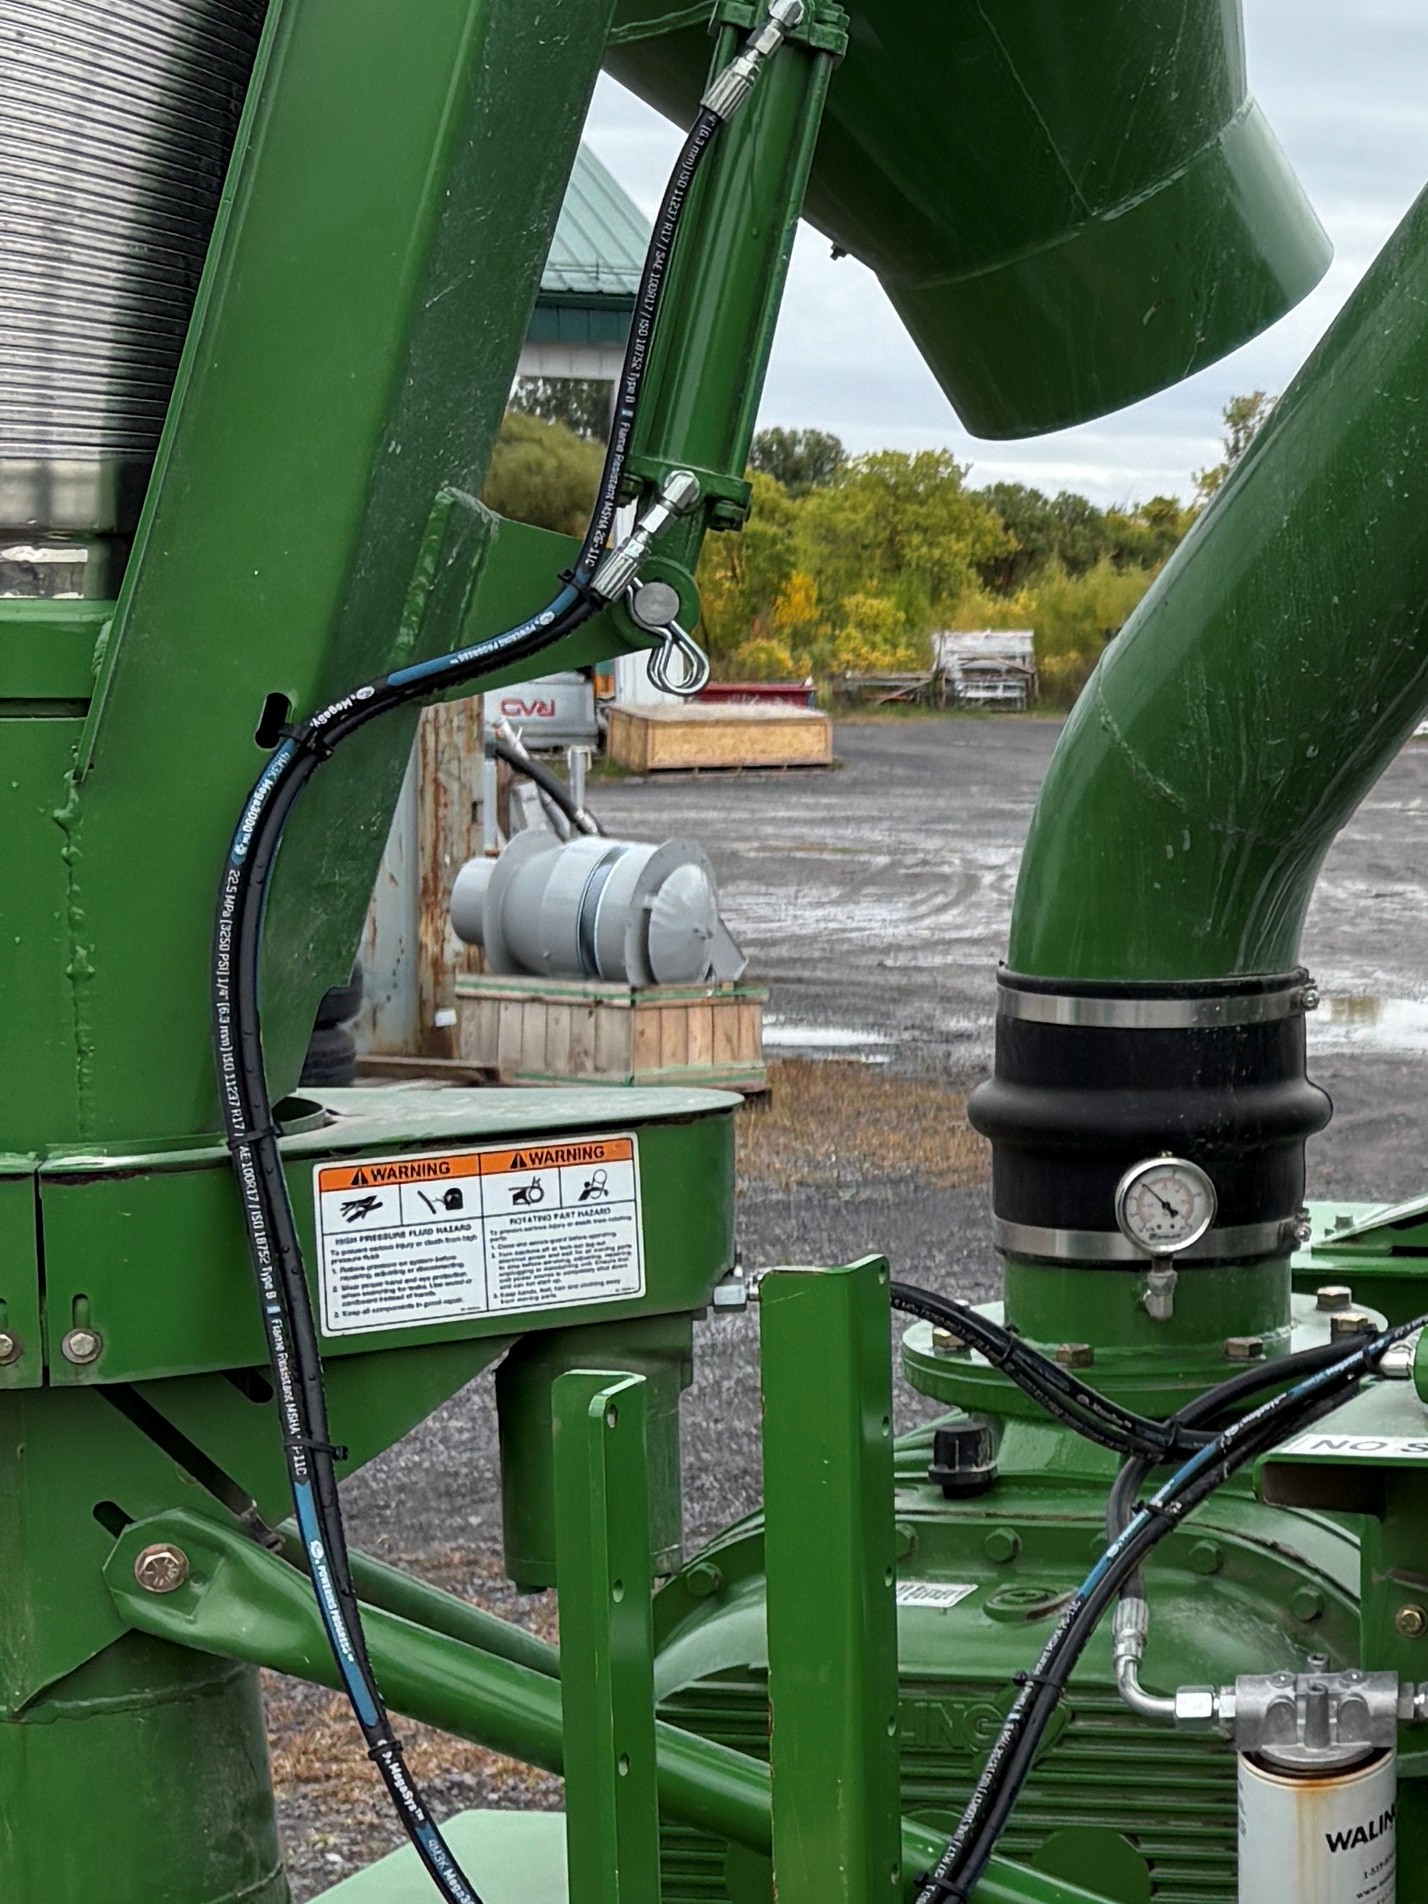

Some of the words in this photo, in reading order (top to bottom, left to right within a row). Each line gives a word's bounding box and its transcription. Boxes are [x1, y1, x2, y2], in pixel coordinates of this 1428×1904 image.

[226, 869, 240, 893] 22.5
[221, 894, 236, 918] MPa
[222, 1053, 235, 1072] ISO
[224, 1074, 240, 1106] 11237
[230, 1109, 245, 1129] R17
[529, 1146, 605, 1166] WARNING
[240, 1163, 260, 1202] 100R17
[371, 1162, 451, 1183] WARNING
[250, 1212, 264, 1228] ISO
[554, 1211, 575, 1220] PART
[577, 1207, 612, 1218] HAZARD
[436, 1224, 472, 1234] HAZARD
[254, 1231, 270, 1265] 18752
[259, 1267, 275, 1290] Type
[270, 1319, 287, 1352] Flame
[1311, 1439, 1388, 1451] NO
[1325, 1804, 1396, 1853] WALIN
